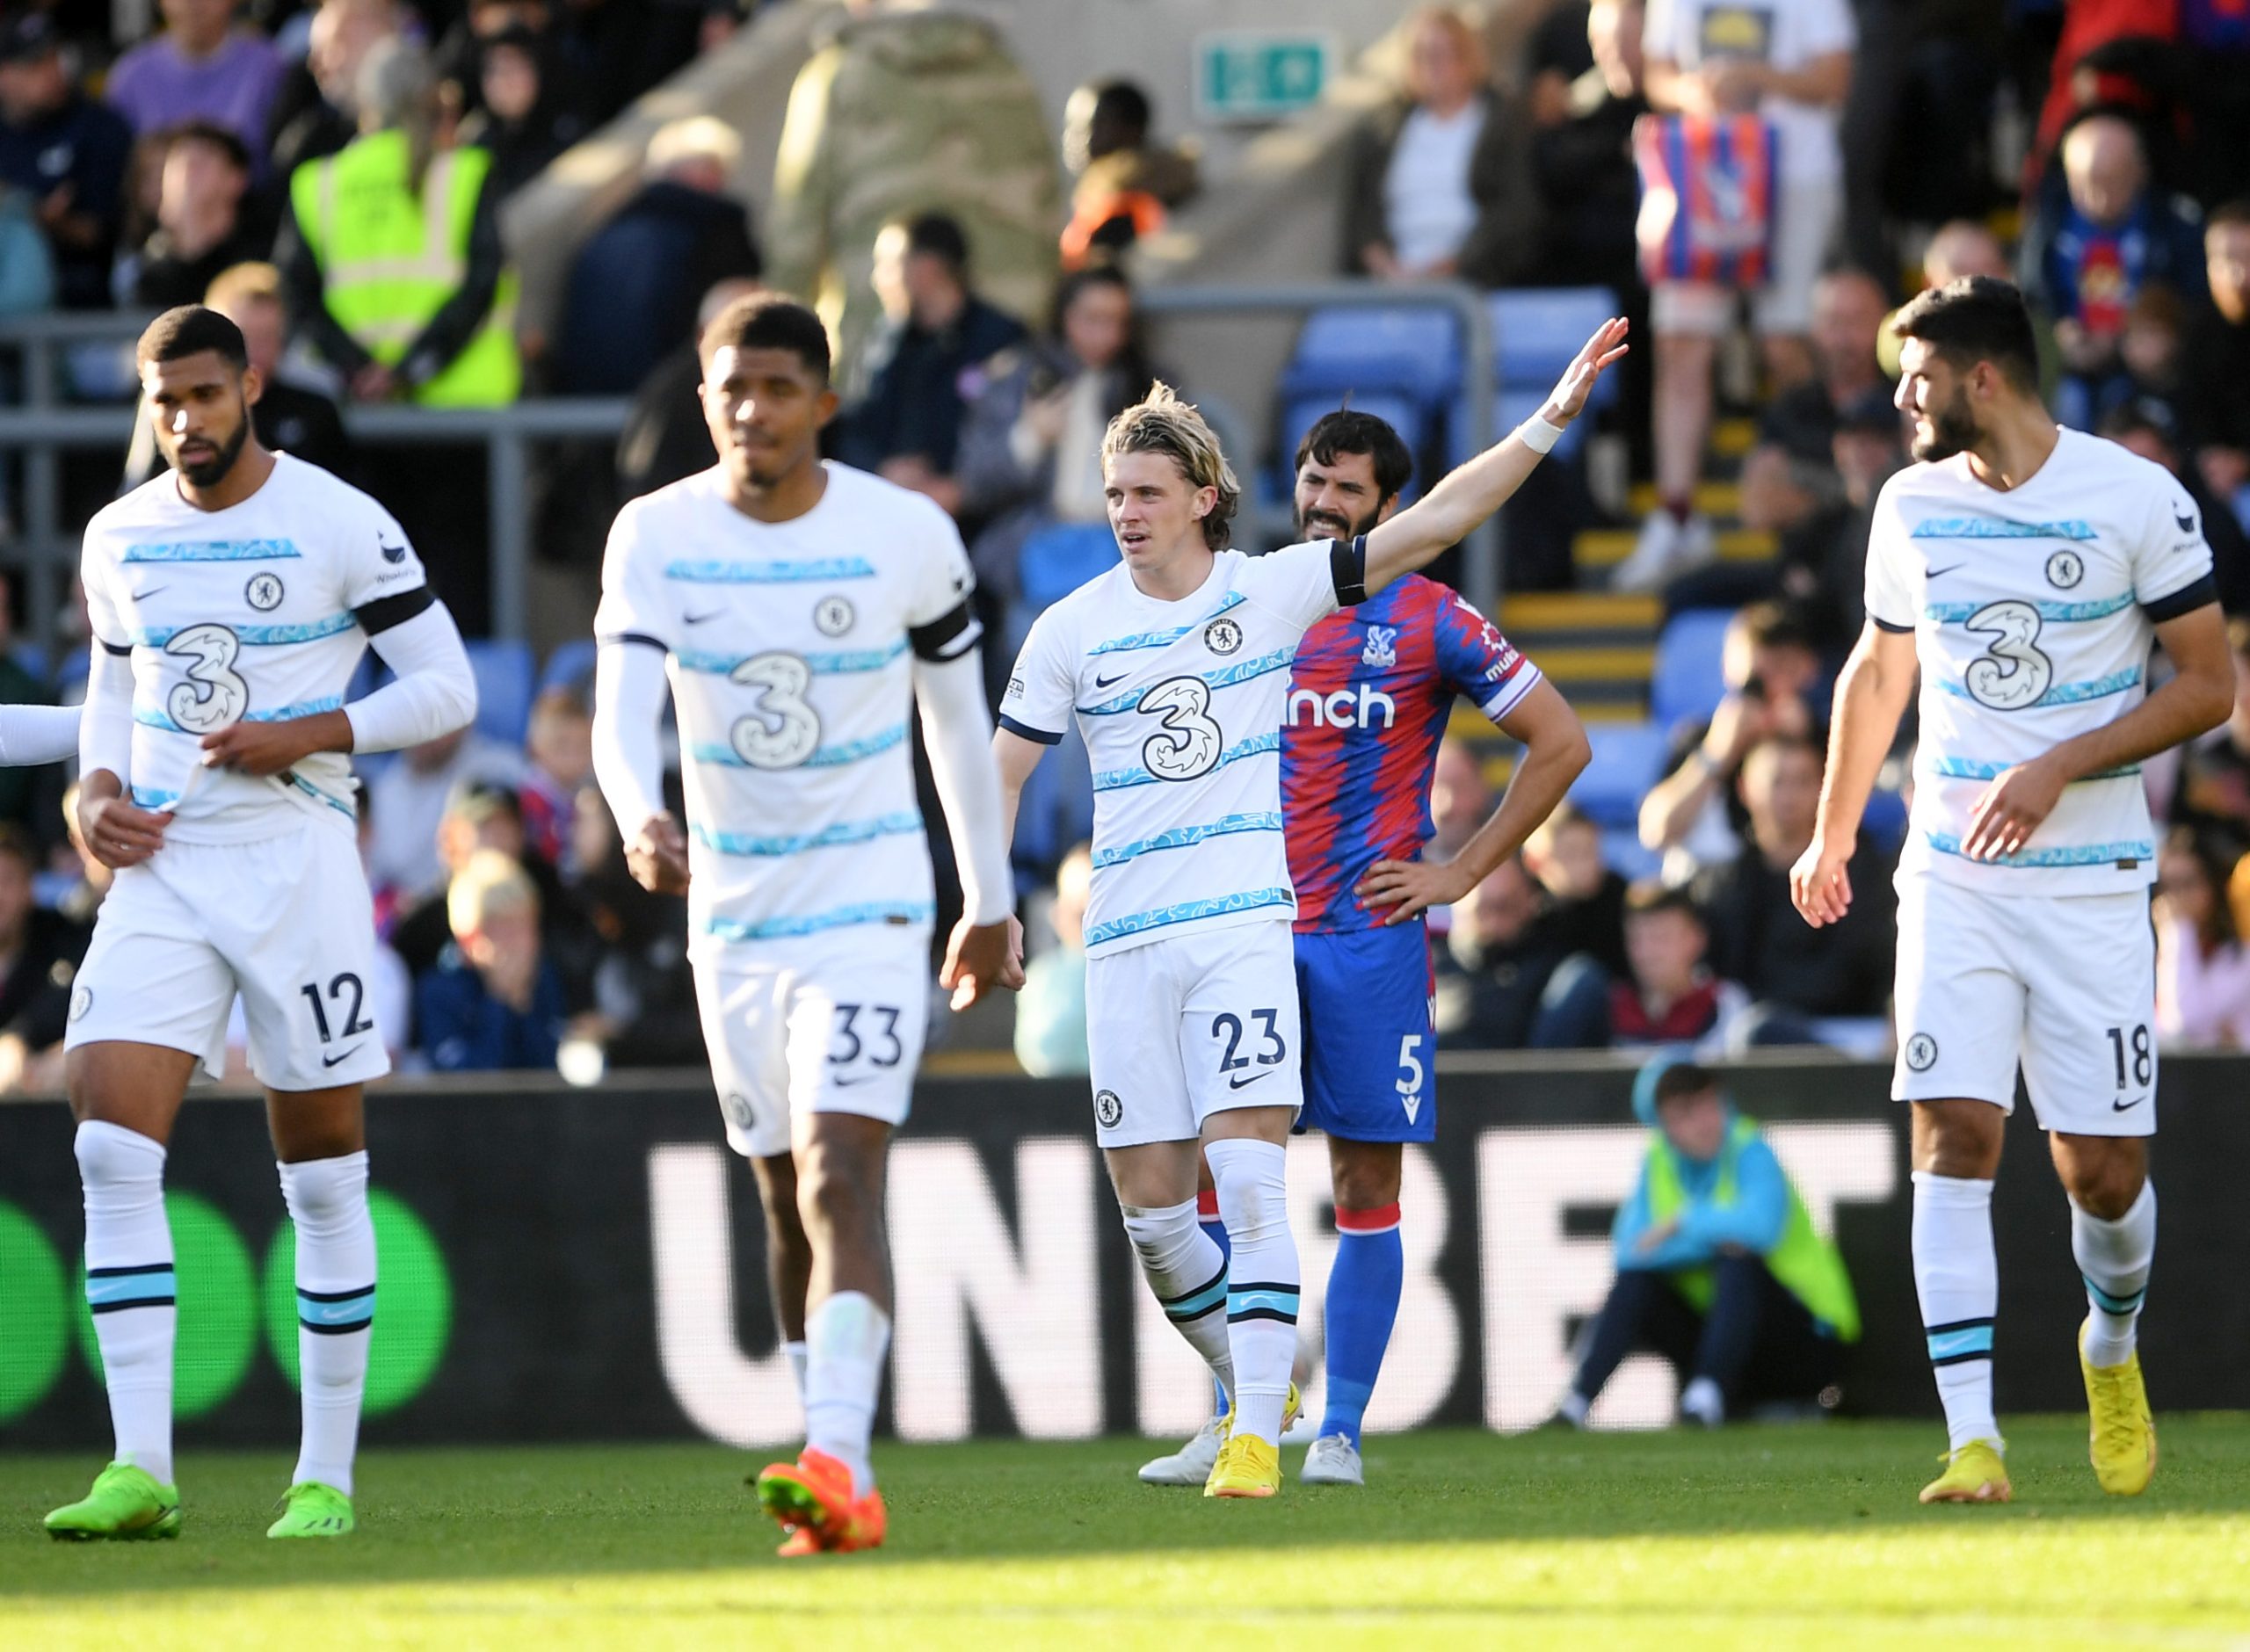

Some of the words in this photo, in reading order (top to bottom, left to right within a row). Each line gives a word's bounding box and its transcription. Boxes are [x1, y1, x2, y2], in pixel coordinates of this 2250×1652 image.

[163, 622, 250, 735] 3
[1963, 599, 2053, 712] 3
[729, 651, 822, 770] 3
[1136, 675, 1223, 782] 3
[301, 972, 373, 1043] 12
[827, 1004, 902, 1068] 33
[1212, 1009, 1287, 1073] 23
[1396, 1034, 1424, 1095] 5
[2107, 1024, 2152, 1090] 18
[649, 1123, 1896, 1448] UNBE
